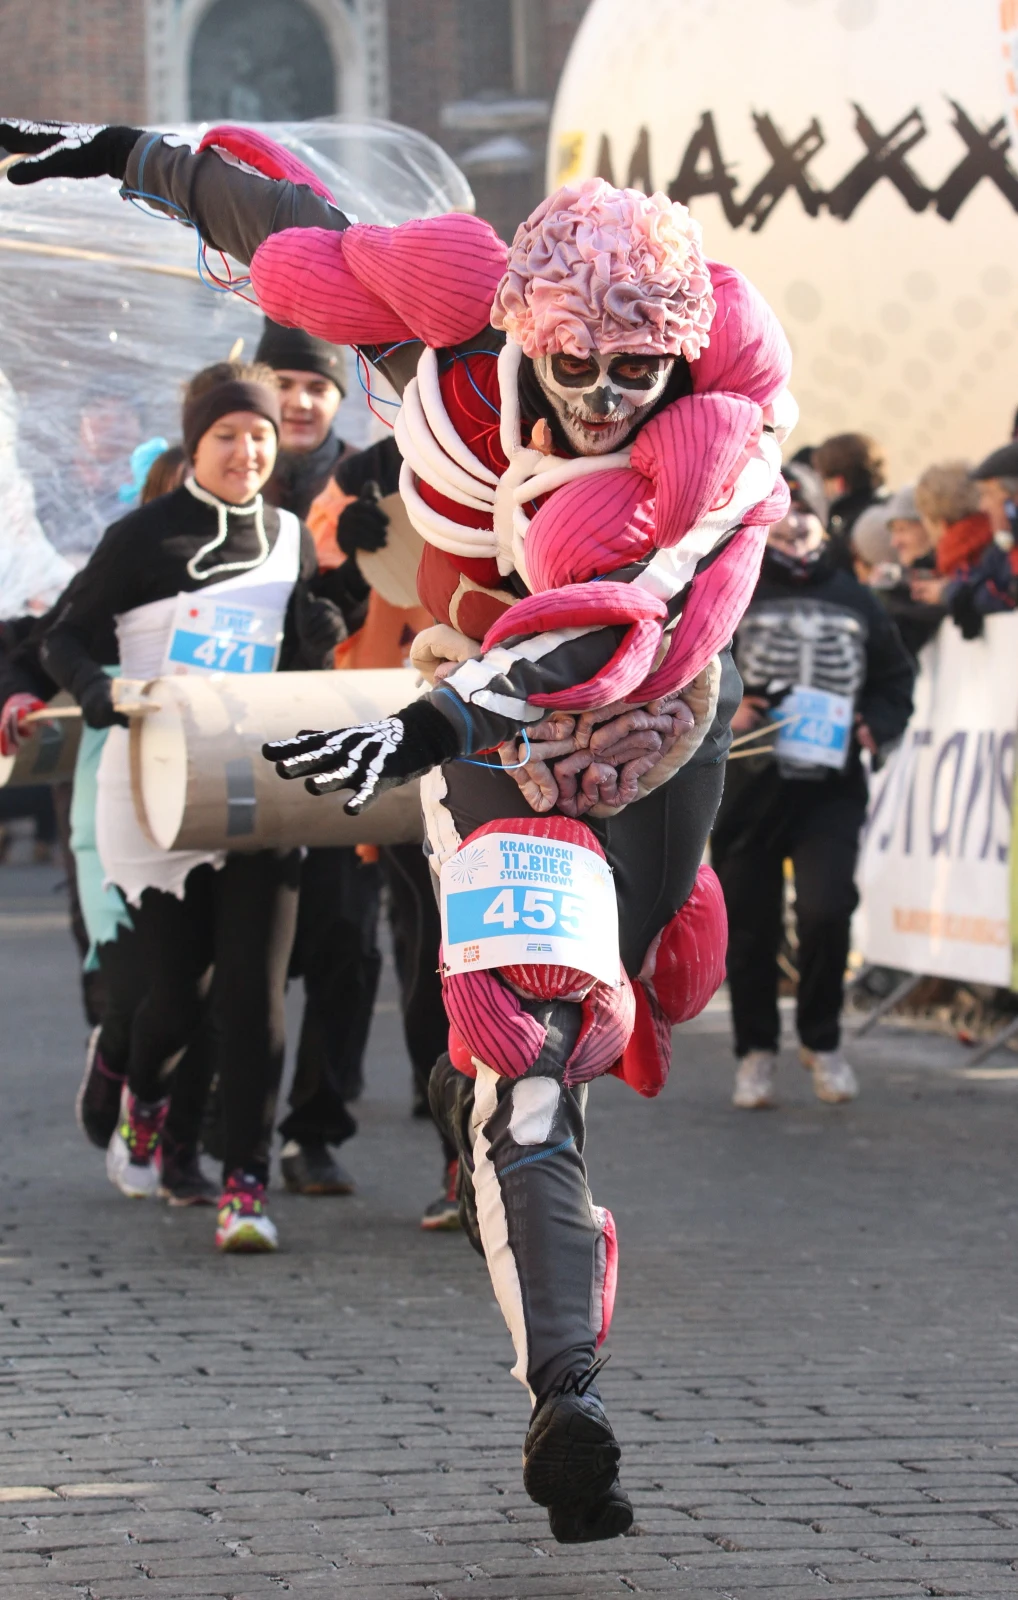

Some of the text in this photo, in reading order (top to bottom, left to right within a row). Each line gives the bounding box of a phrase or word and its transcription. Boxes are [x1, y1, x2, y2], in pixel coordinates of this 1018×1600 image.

[193, 636, 255, 673] 471
[499, 840, 574, 861] KRAKOWSKI
[502, 852, 572, 877] 11.BIEG
[499, 870, 574, 887] SYLWESTROWY
[483, 888, 591, 936] 455
